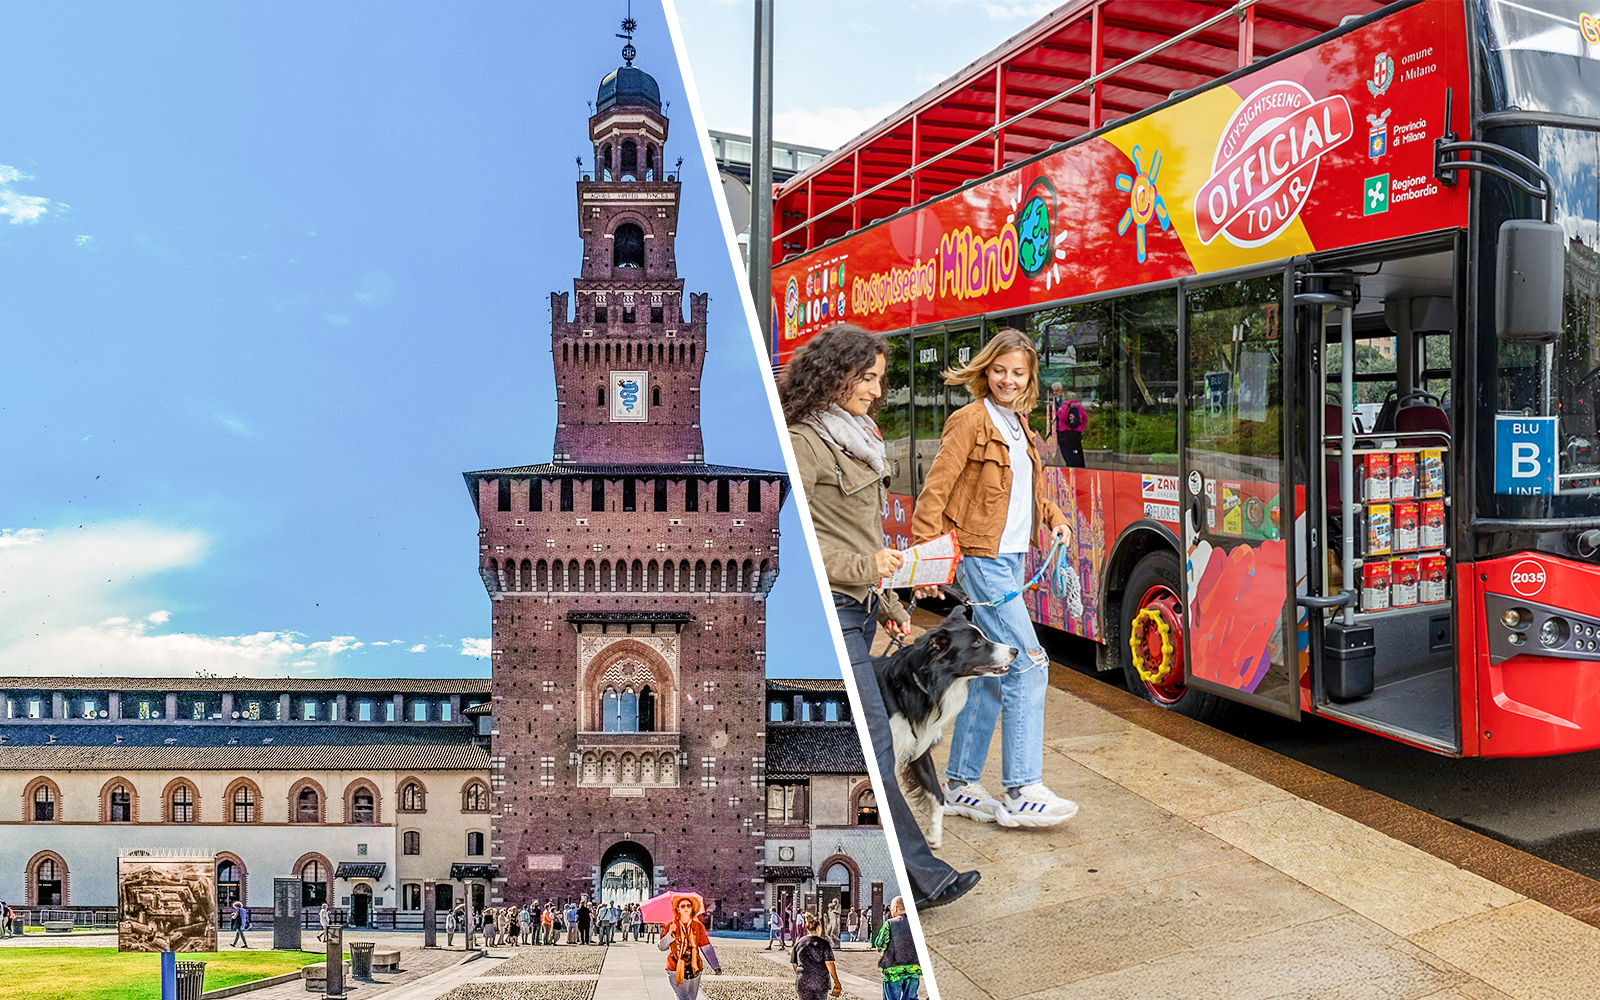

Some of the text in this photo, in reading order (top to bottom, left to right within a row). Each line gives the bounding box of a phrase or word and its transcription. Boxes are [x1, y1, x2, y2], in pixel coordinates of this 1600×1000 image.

[1405, 63, 1437, 81] Milano
[1223, 93, 1302, 159] CITYSIGHTSEEING
[1393, 118, 1427, 136] Provincia
[1393, 131, 1426, 147] di Milano
[1208, 106, 1342, 225] OFFICIAL
[1392, 175, 1427, 191] Regione
[1391, 184, 1438, 203] Lombardia
[1247, 176, 1307, 234] TOUR
[919, 348, 938, 364] USCITA
[958, 346, 971, 363] EXIT
[1513, 423, 1539, 434] BLU
[1512, 442, 1541, 478] B
[893, 497, 905, 525] On
[1513, 572, 1544, 583] 2035
